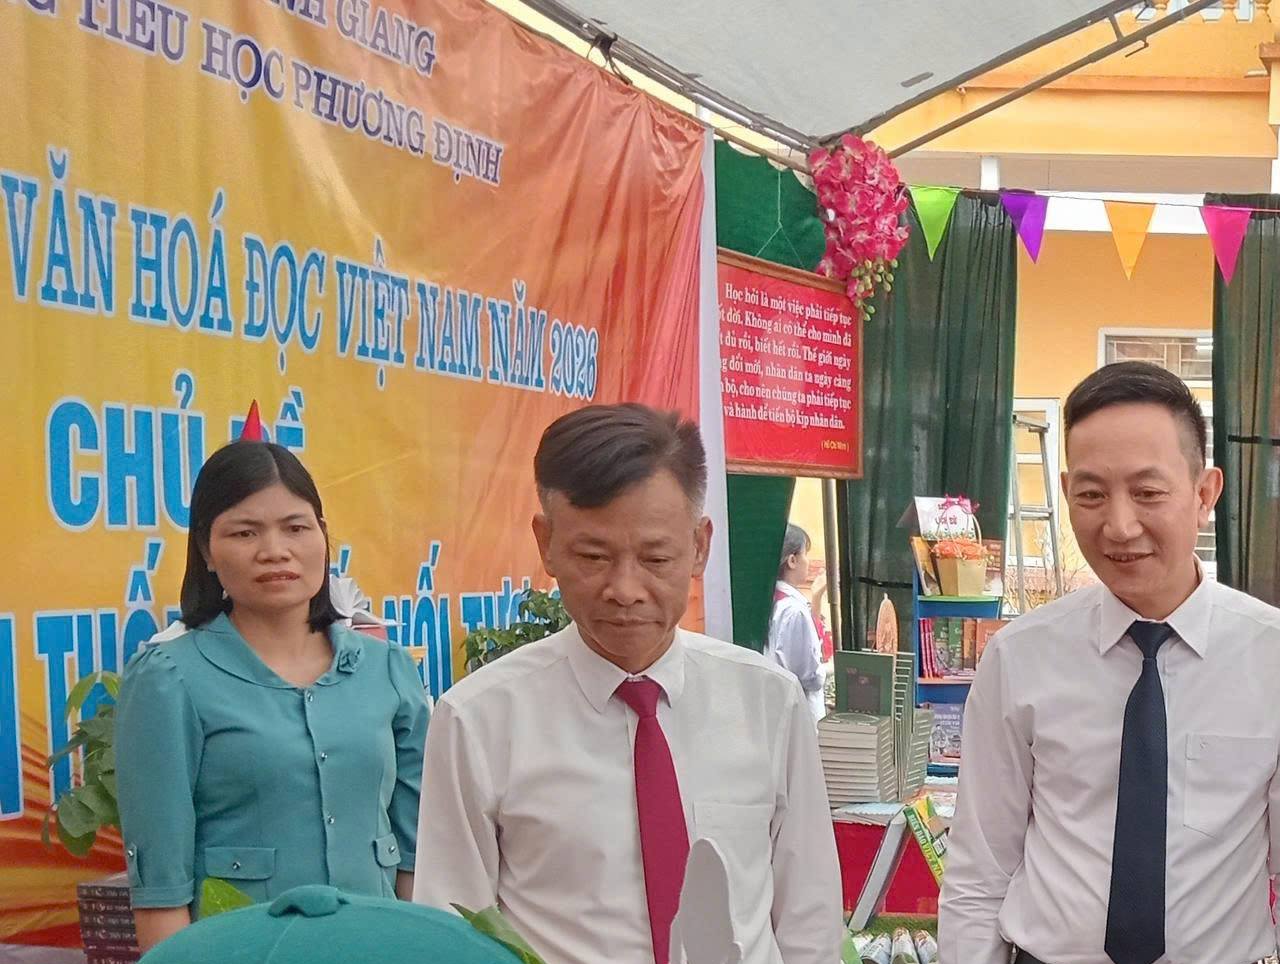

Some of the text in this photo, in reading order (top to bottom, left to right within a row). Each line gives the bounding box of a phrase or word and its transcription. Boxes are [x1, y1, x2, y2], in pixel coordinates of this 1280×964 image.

[337, 0, 437, 75] GIANG
[200, 22, 285, 101] HỌC
[291, 60, 425, 154] PHƯƠNG
[434, 120, 503, 183] ĐỊNH
[0, 149, 598, 401] VĂN HOÁ ĐỌC VIỆT NAM NĂM 2026
[725, 283, 743, 304] Học
[770, 296, 786, 314] một
[745, 310, 772, 334] Không
[774, 318, 781, 333] ai
[808, 324, 821, 340] cho
[739, 380, 754, 396] cho
[805, 371, 813, 383] ta
